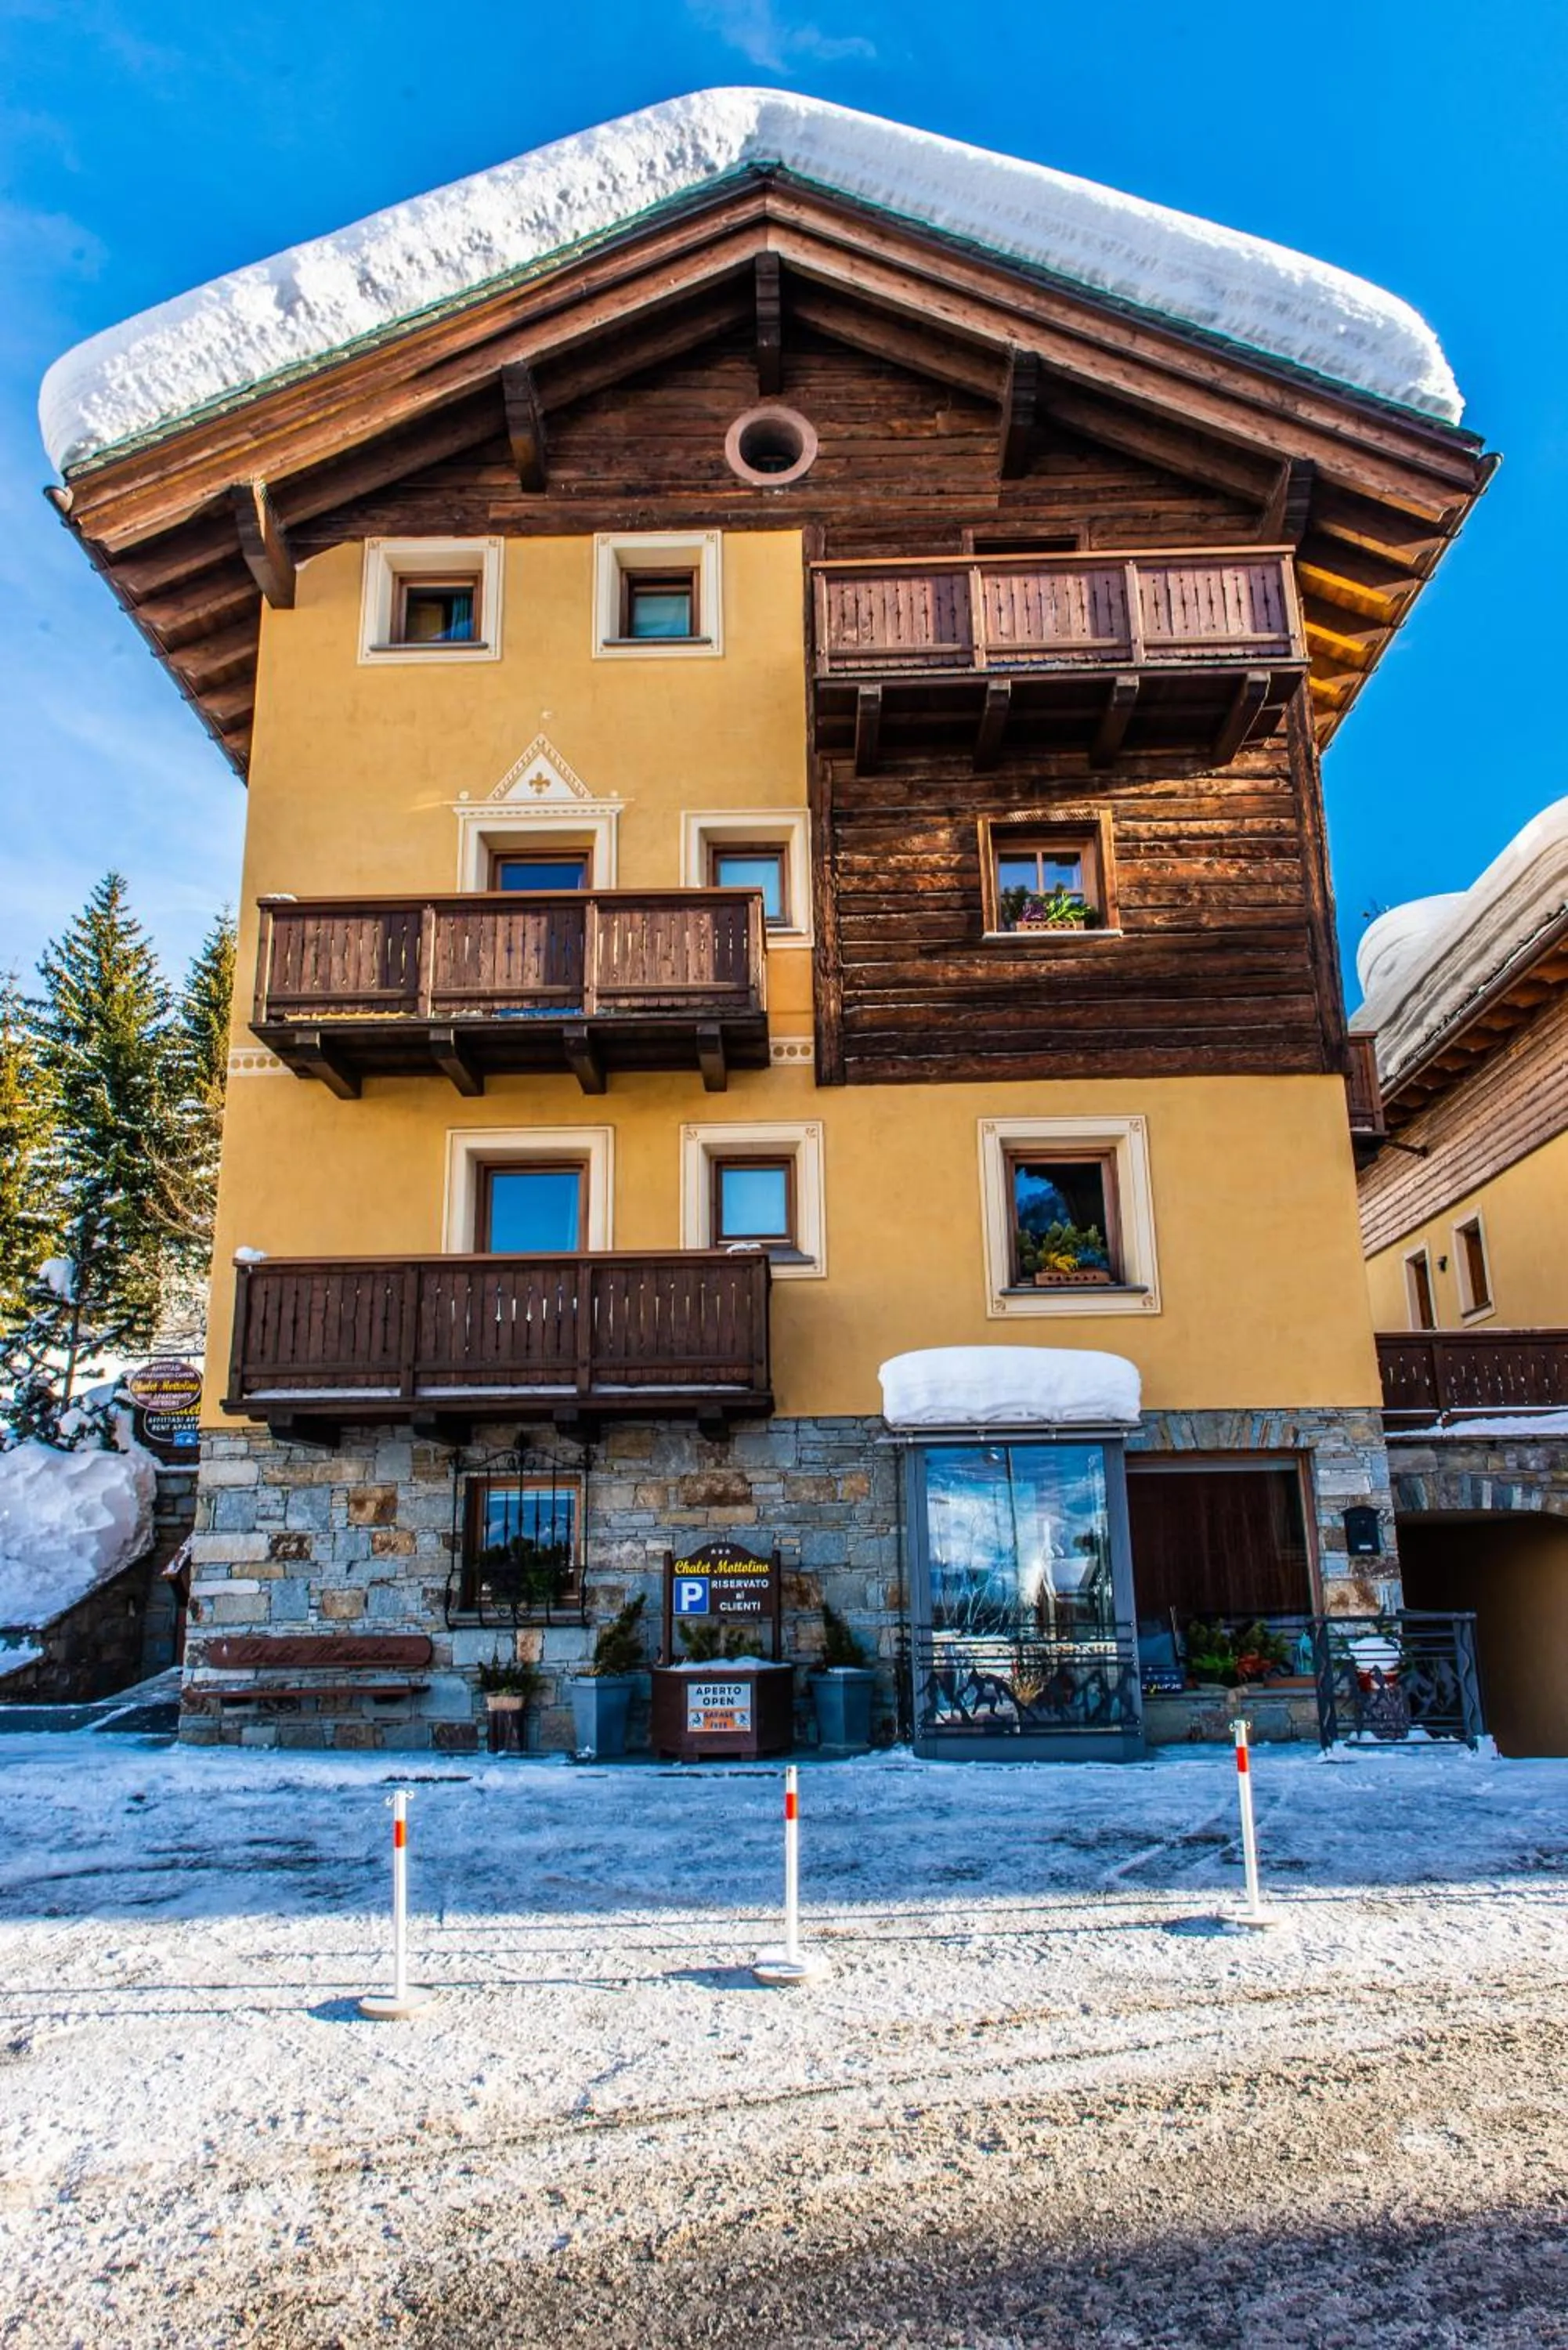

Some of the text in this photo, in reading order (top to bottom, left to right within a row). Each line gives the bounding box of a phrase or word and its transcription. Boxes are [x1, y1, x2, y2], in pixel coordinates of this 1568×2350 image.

[674, 1558, 770, 1574] Chalet Mottolino
[711, 1578, 770, 1589] RISERVATO
[681, 1582, 703, 1611] P
[719, 1600, 761, 1611] CLIENTI
[695, 1686, 742, 1696] APERTO
[703, 1697, 735, 1706] OPEN
